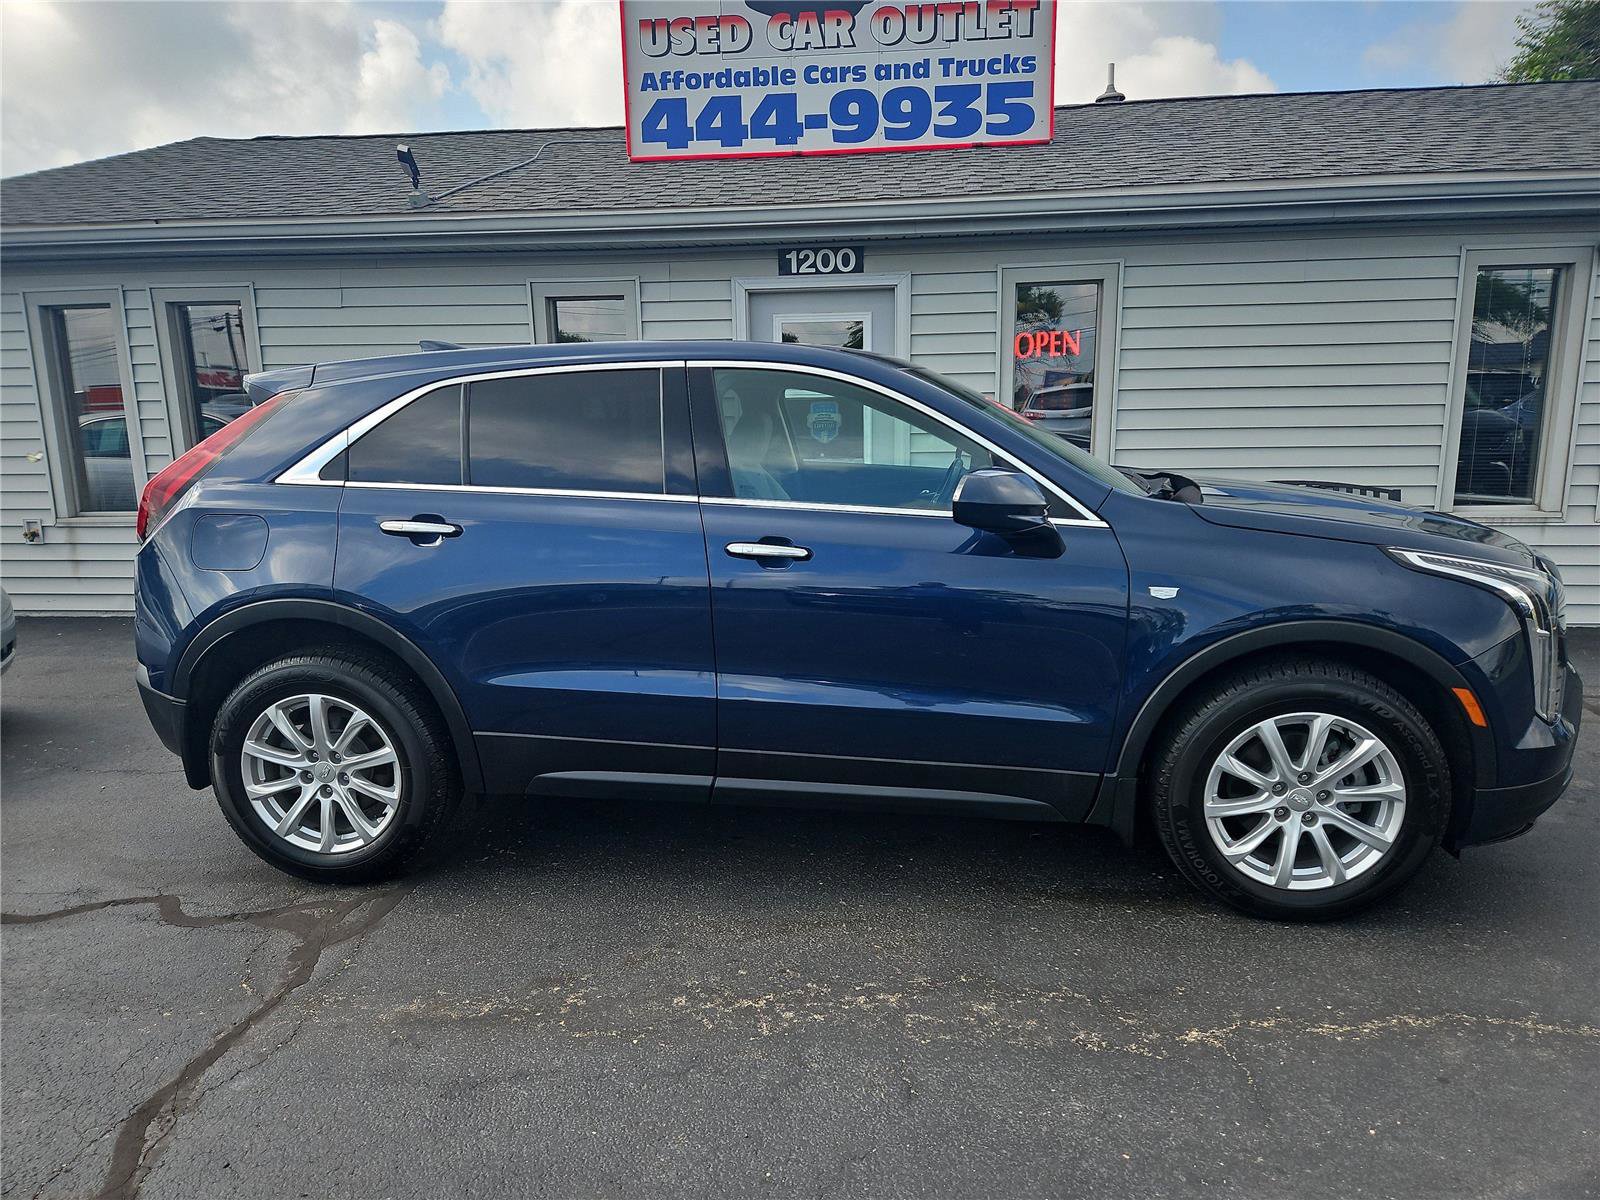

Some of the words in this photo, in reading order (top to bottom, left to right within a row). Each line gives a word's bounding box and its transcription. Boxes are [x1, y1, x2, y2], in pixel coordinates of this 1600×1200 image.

[639, 15, 752, 57] USED
[766, 10, 857, 51] CAR
[870, 0, 1041, 46] OUTLET
[641, 66, 797, 91] Affordable
[805, 63, 867, 84] Cars
[874, 59, 931, 81] and
[938, 53, 1037, 77] Trucks
[641, 81, 1036, 150] 444-9935
[785, 249, 856, 273] 1200
[1014, 329, 1081, 359] OPEN
